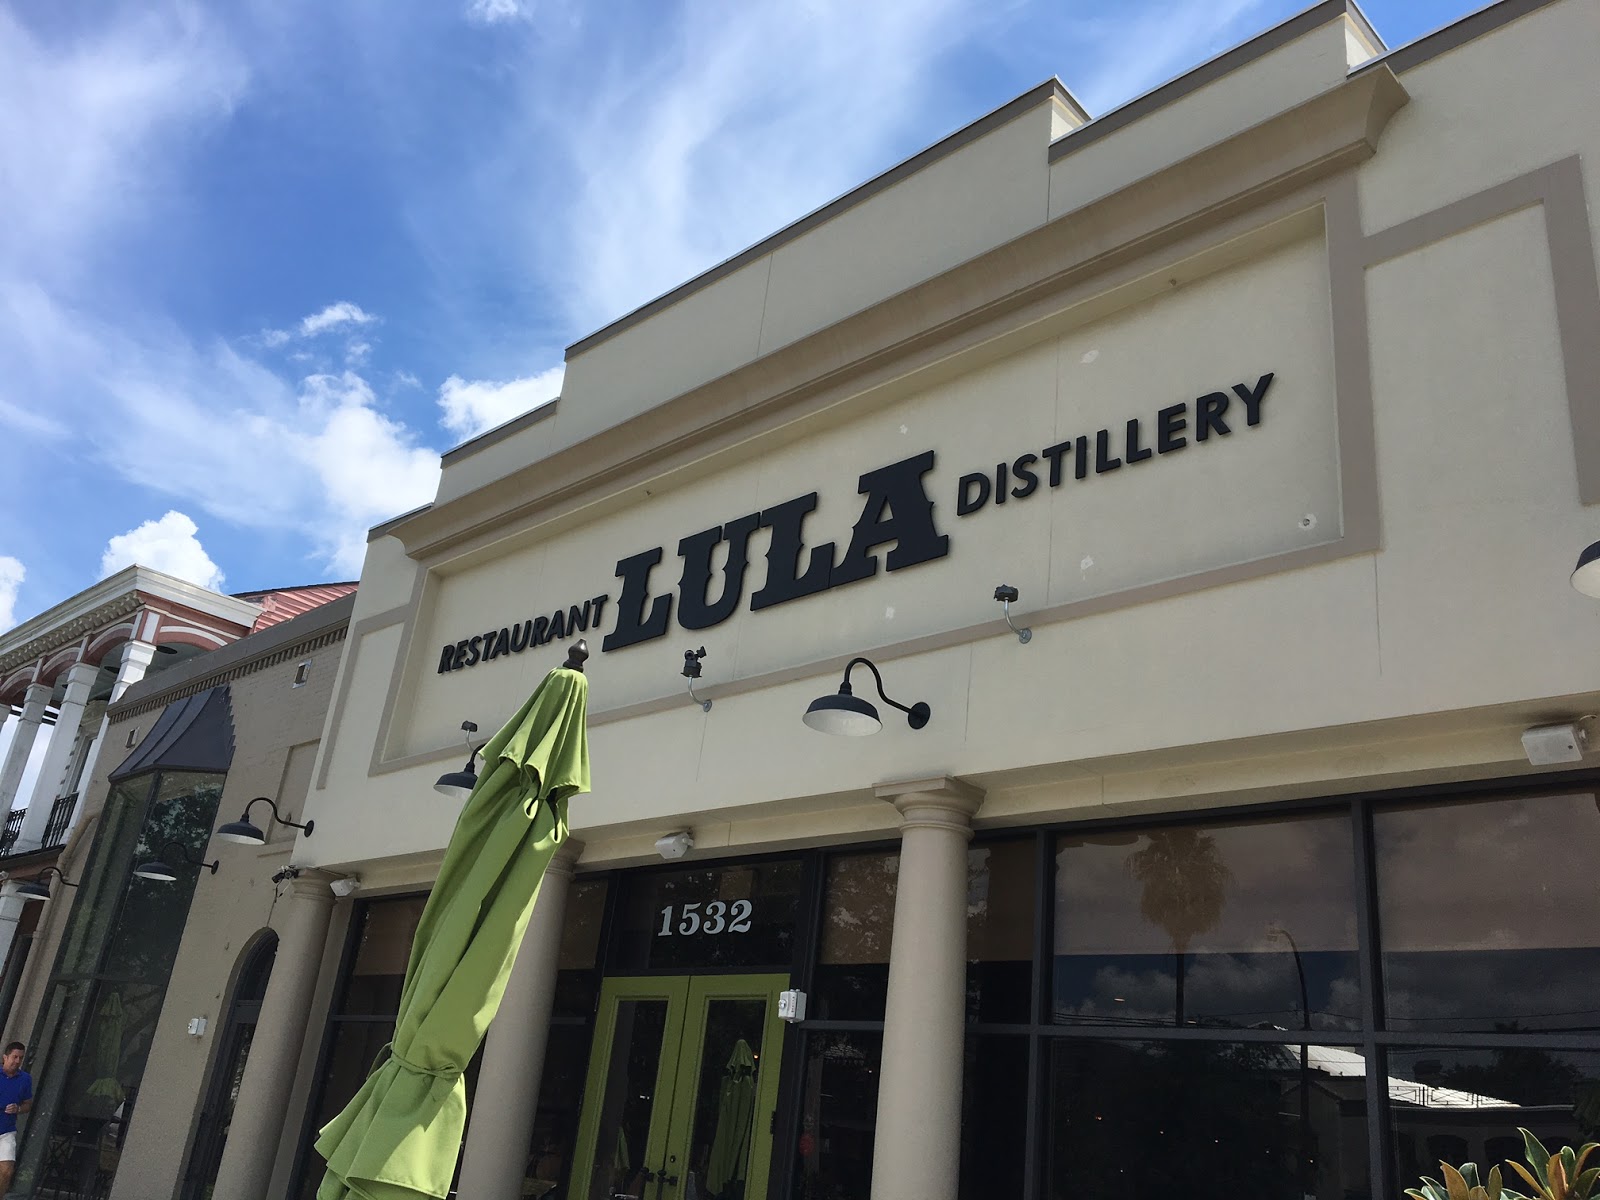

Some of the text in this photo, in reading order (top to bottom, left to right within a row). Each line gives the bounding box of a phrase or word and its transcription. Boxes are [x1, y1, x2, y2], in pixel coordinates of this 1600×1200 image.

[438, 373, 1274, 674] RESTAURANT LULA DISTILLERY
[658, 899, 753, 937] 1532
